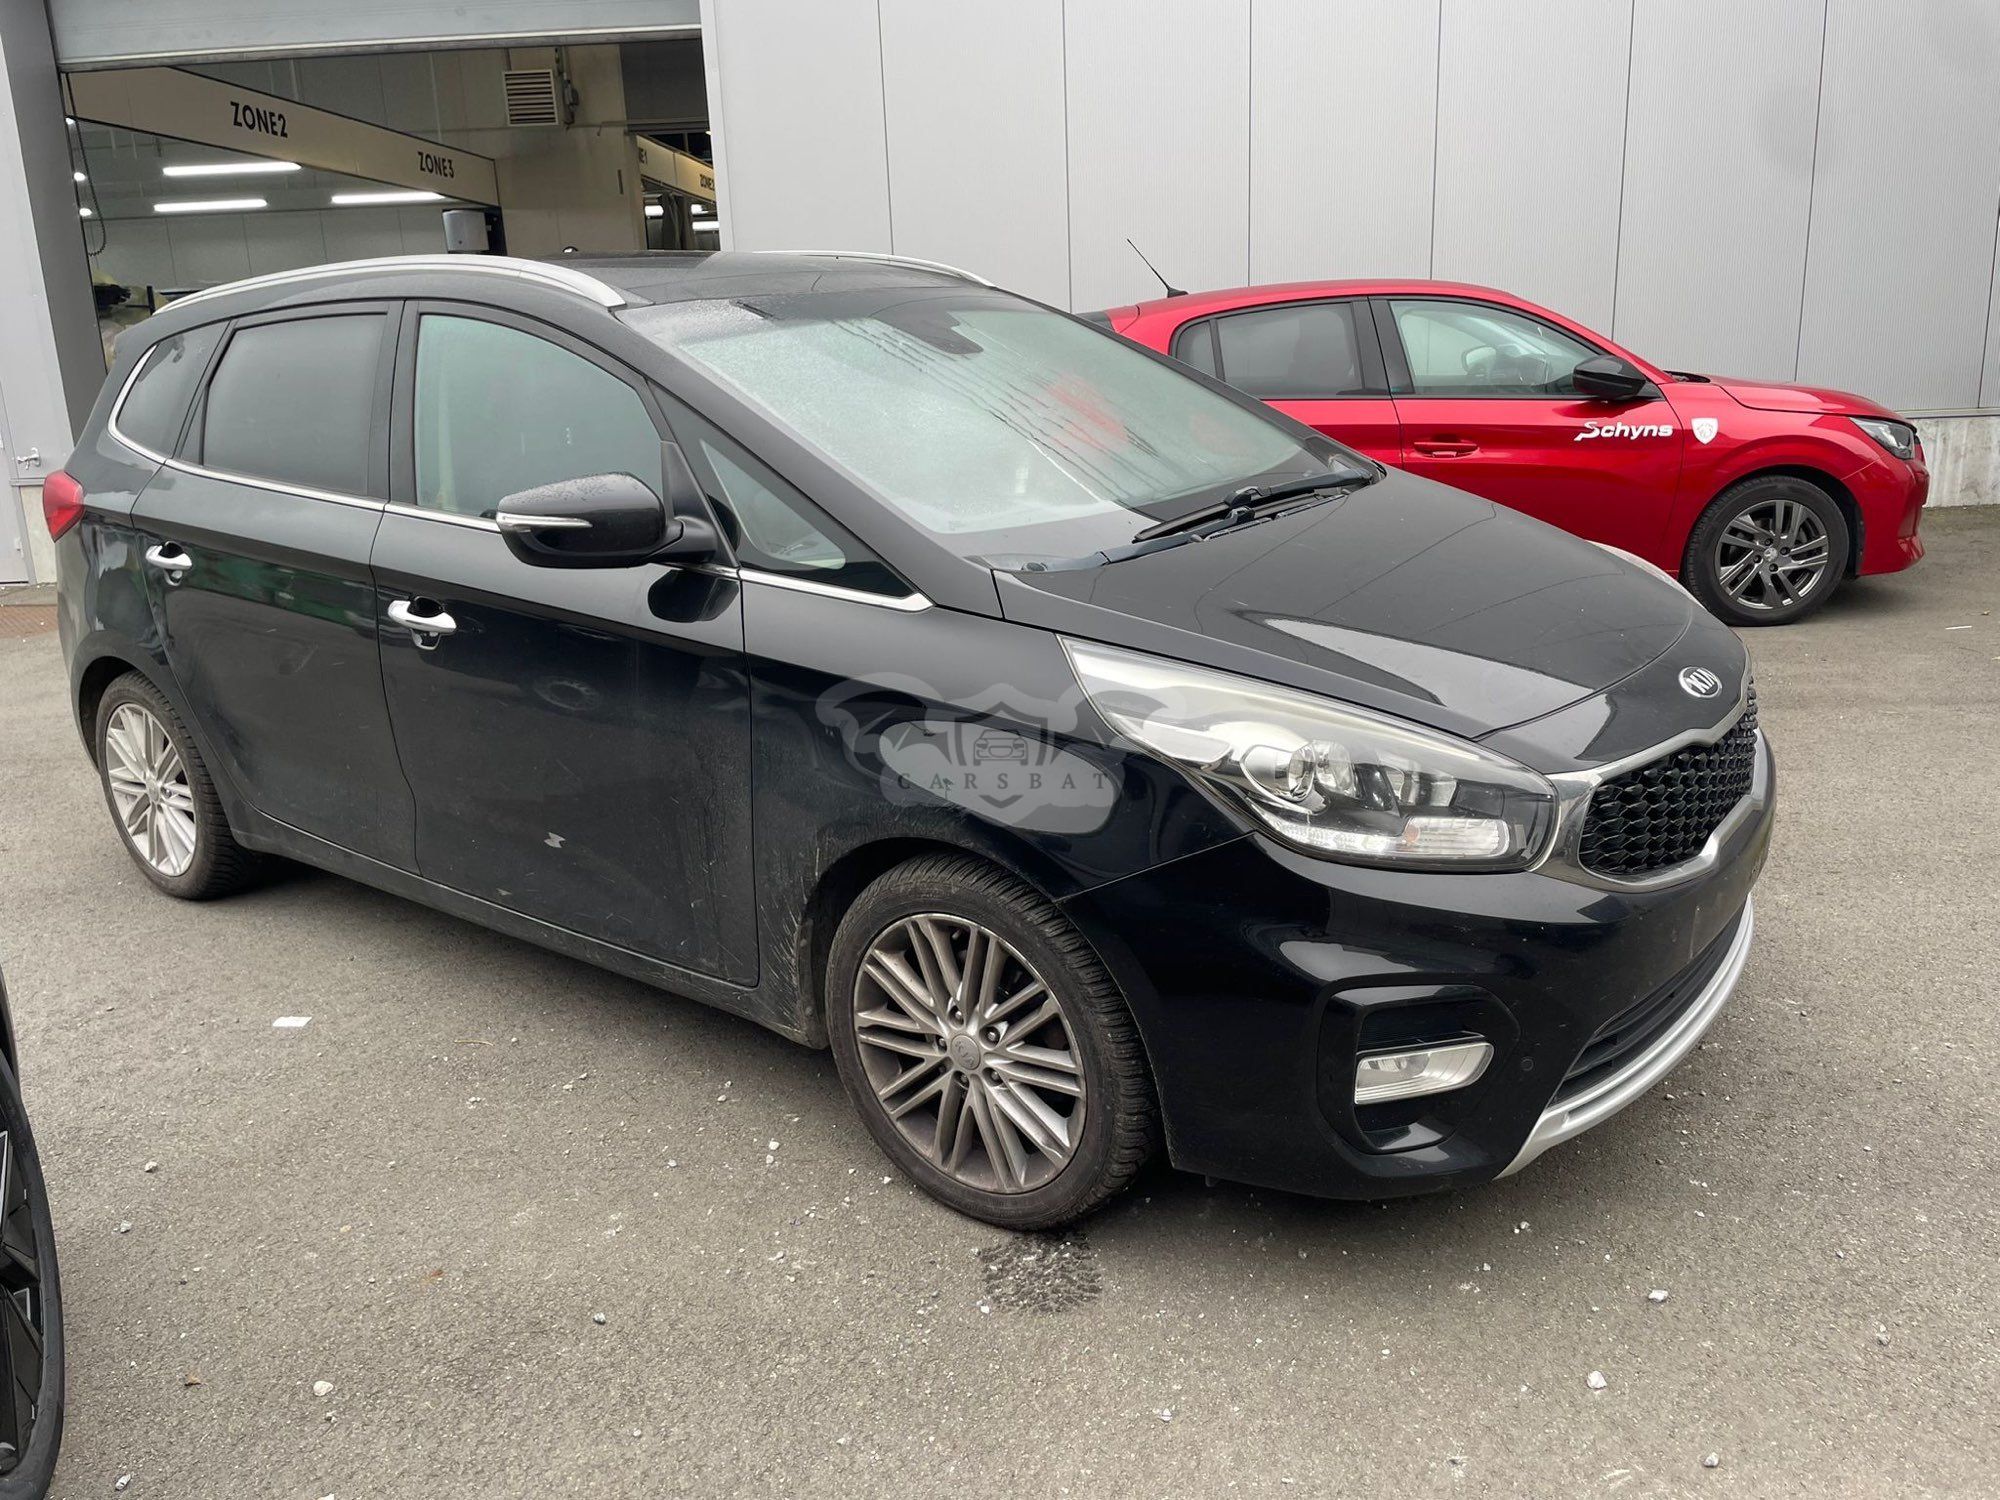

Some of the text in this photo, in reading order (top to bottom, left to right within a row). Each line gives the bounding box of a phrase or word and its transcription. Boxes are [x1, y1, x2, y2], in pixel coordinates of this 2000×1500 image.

[230, 101, 288, 138] ZONE2
[417, 151, 454, 178] ZONE3
[1573, 421, 1673, 441] Schyns
